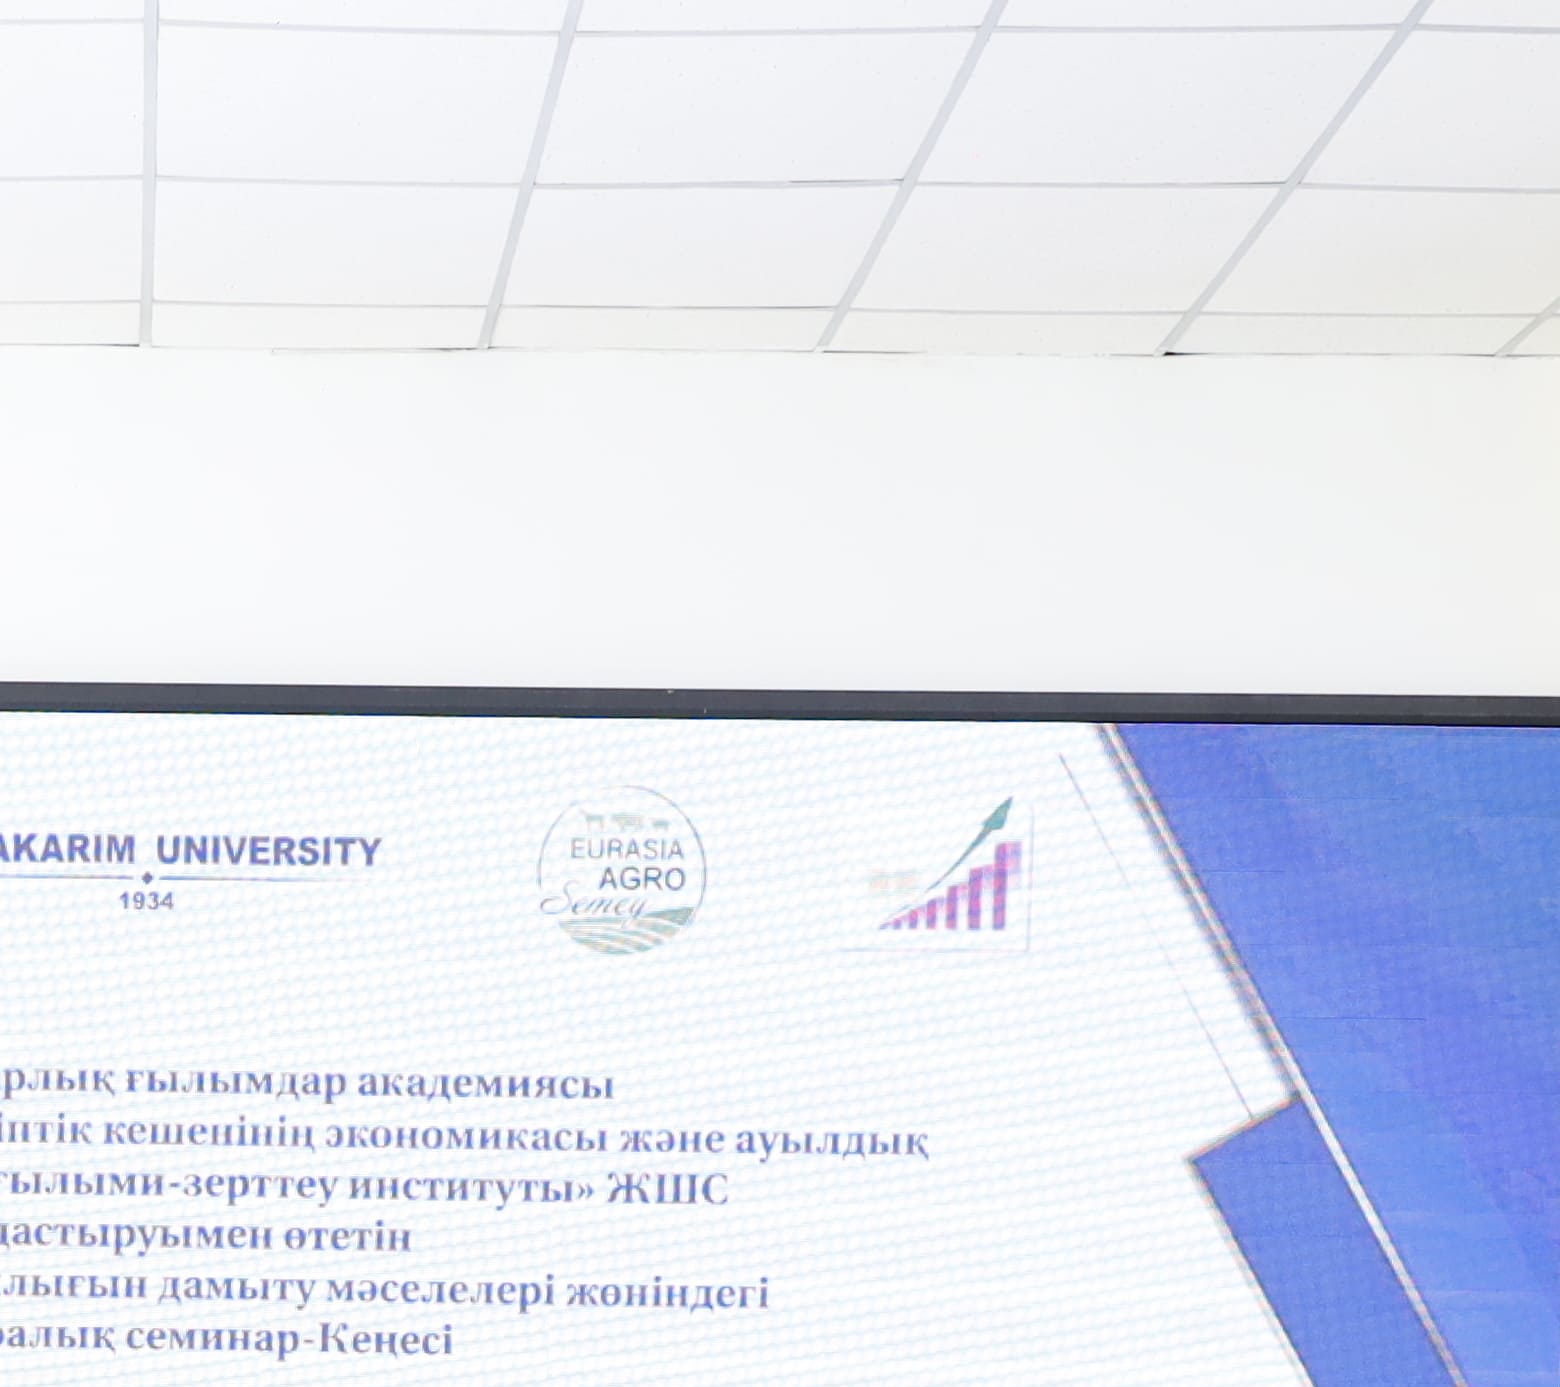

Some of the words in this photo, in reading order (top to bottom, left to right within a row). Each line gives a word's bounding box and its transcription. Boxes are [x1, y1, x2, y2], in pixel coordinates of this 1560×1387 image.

[157, 835, 382, 867] UNIVERSITY
[570, 838, 685, 860] EURASIA
[598, 867, 687, 891] AGRO
[119, 890, 175, 911] 1934
[125, 1069, 346, 1105] ғылымдар
[358, 1073, 615, 1102] академиясы
[104, 1114, 315, 1152] кешенінің
[325, 1125, 607, 1152] экономикасы
[620, 1129, 725, 1154] және
[735, 1130, 929, 1160] ауылдық
[349, 1176, 594, 1212] институты»
[607, 1171, 729, 1205] ЖШС
[283, 1219, 412, 1252] өтетін
[158, 1276, 316, 1308] дамыту
[327, 1273, 555, 1315] мәселелері
[566, 1275, 769, 1312] жөніндегі
[125, 1322, 453, 1362] семинар-Кеңесі
